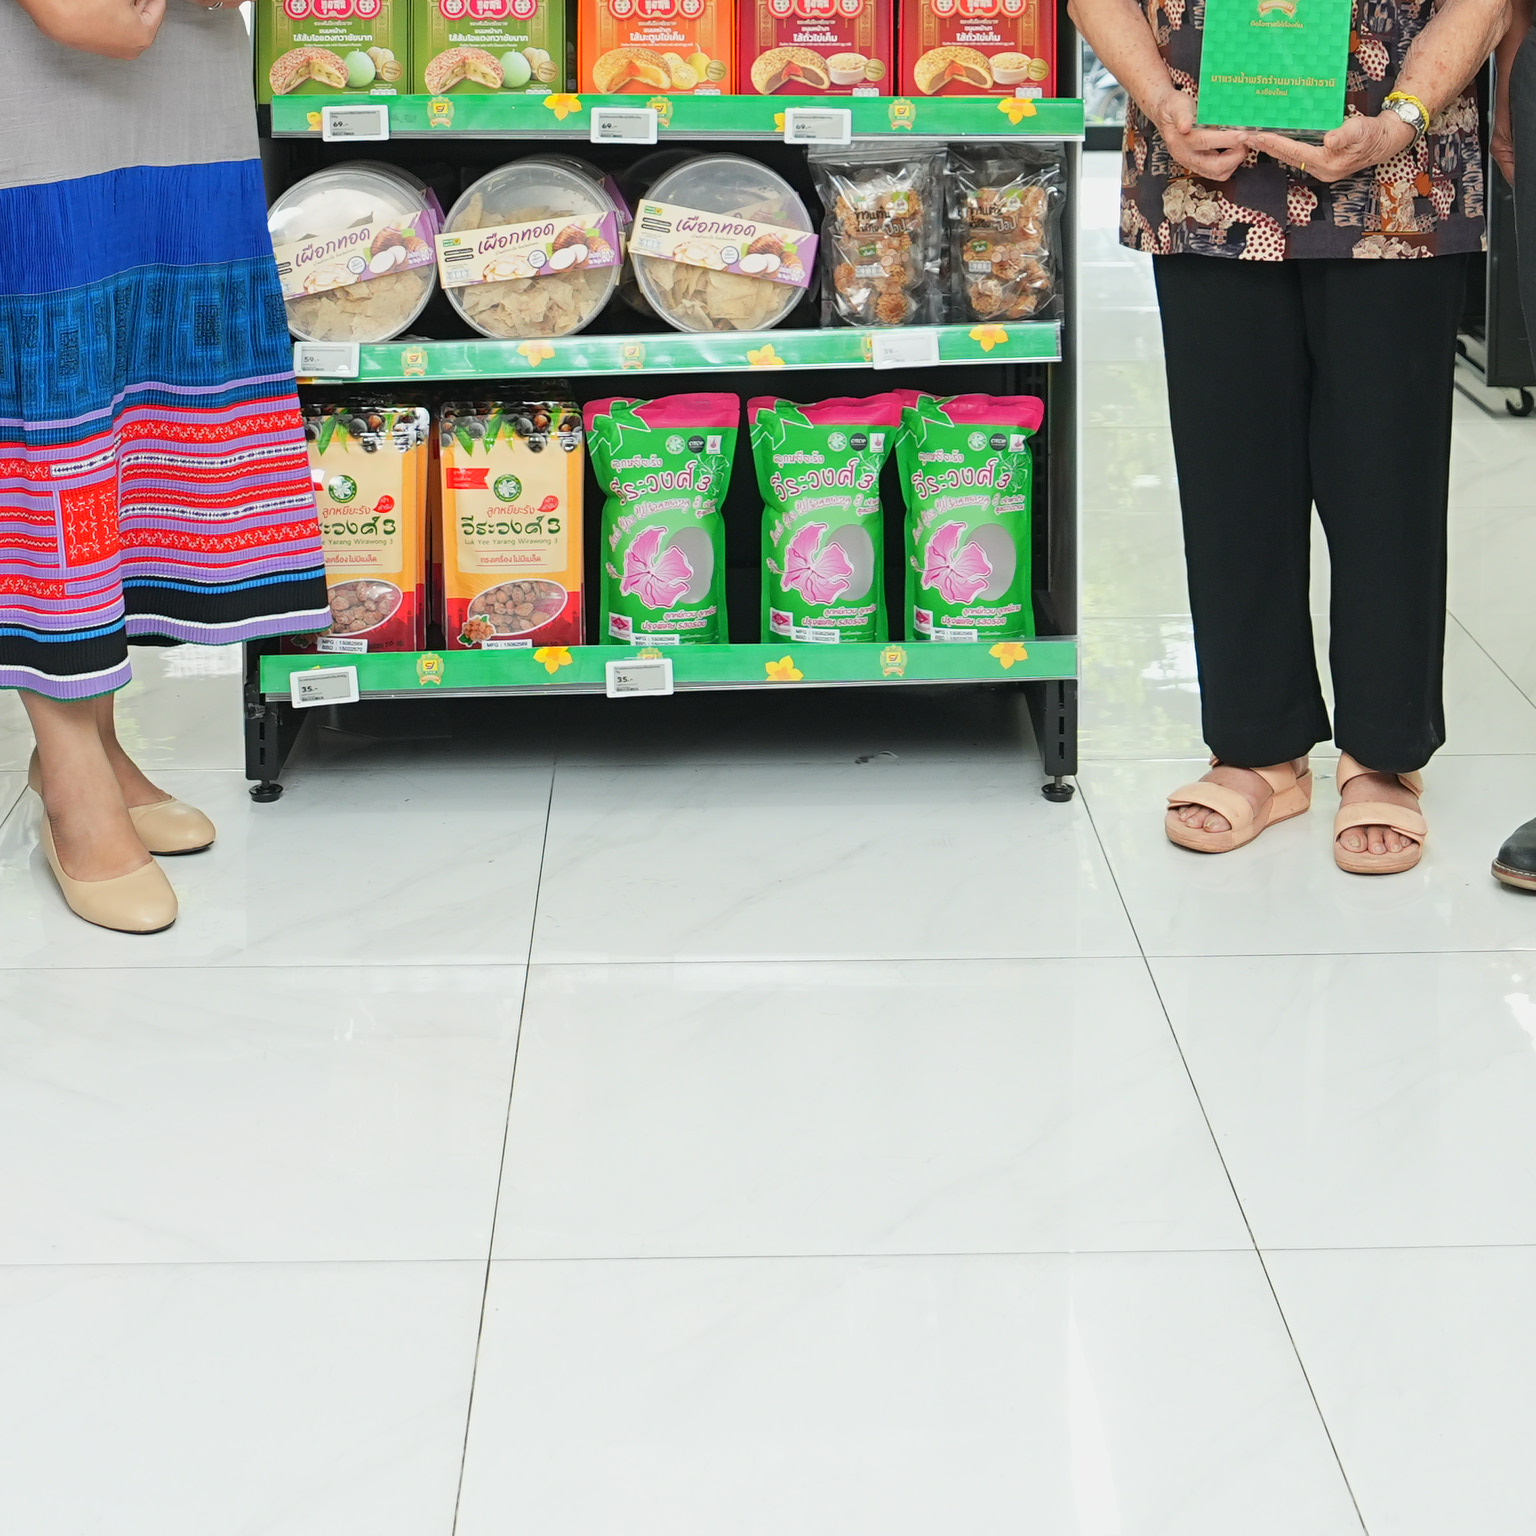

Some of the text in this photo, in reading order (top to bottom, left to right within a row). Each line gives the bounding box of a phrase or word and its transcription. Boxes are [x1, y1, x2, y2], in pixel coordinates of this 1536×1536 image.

[676, 216, 757, 238] เผือกทอด
[295, 228, 371, 267] เผือกทอด
[478, 223, 555, 255] เผือกทอด
[610, 460, 698, 506] วีระวงศ์
[770, 457, 860, 502] วีระวงศ์
[912, 457, 999, 500] วีระวงศ์
[322, 505, 371, 519] ลูกหยียะรัง
[486, 505, 536, 518] ลูกหยียะรัง
[383, 518, 397, 536] 3
[461, 514, 562, 536] วีระวงศ์ 3
[328, 538, 352, 547] Yarang
[354, 537, 388, 547] Wirawong
[492, 538, 516, 547] Yarang
[518, 537, 552, 547] Wirawong
